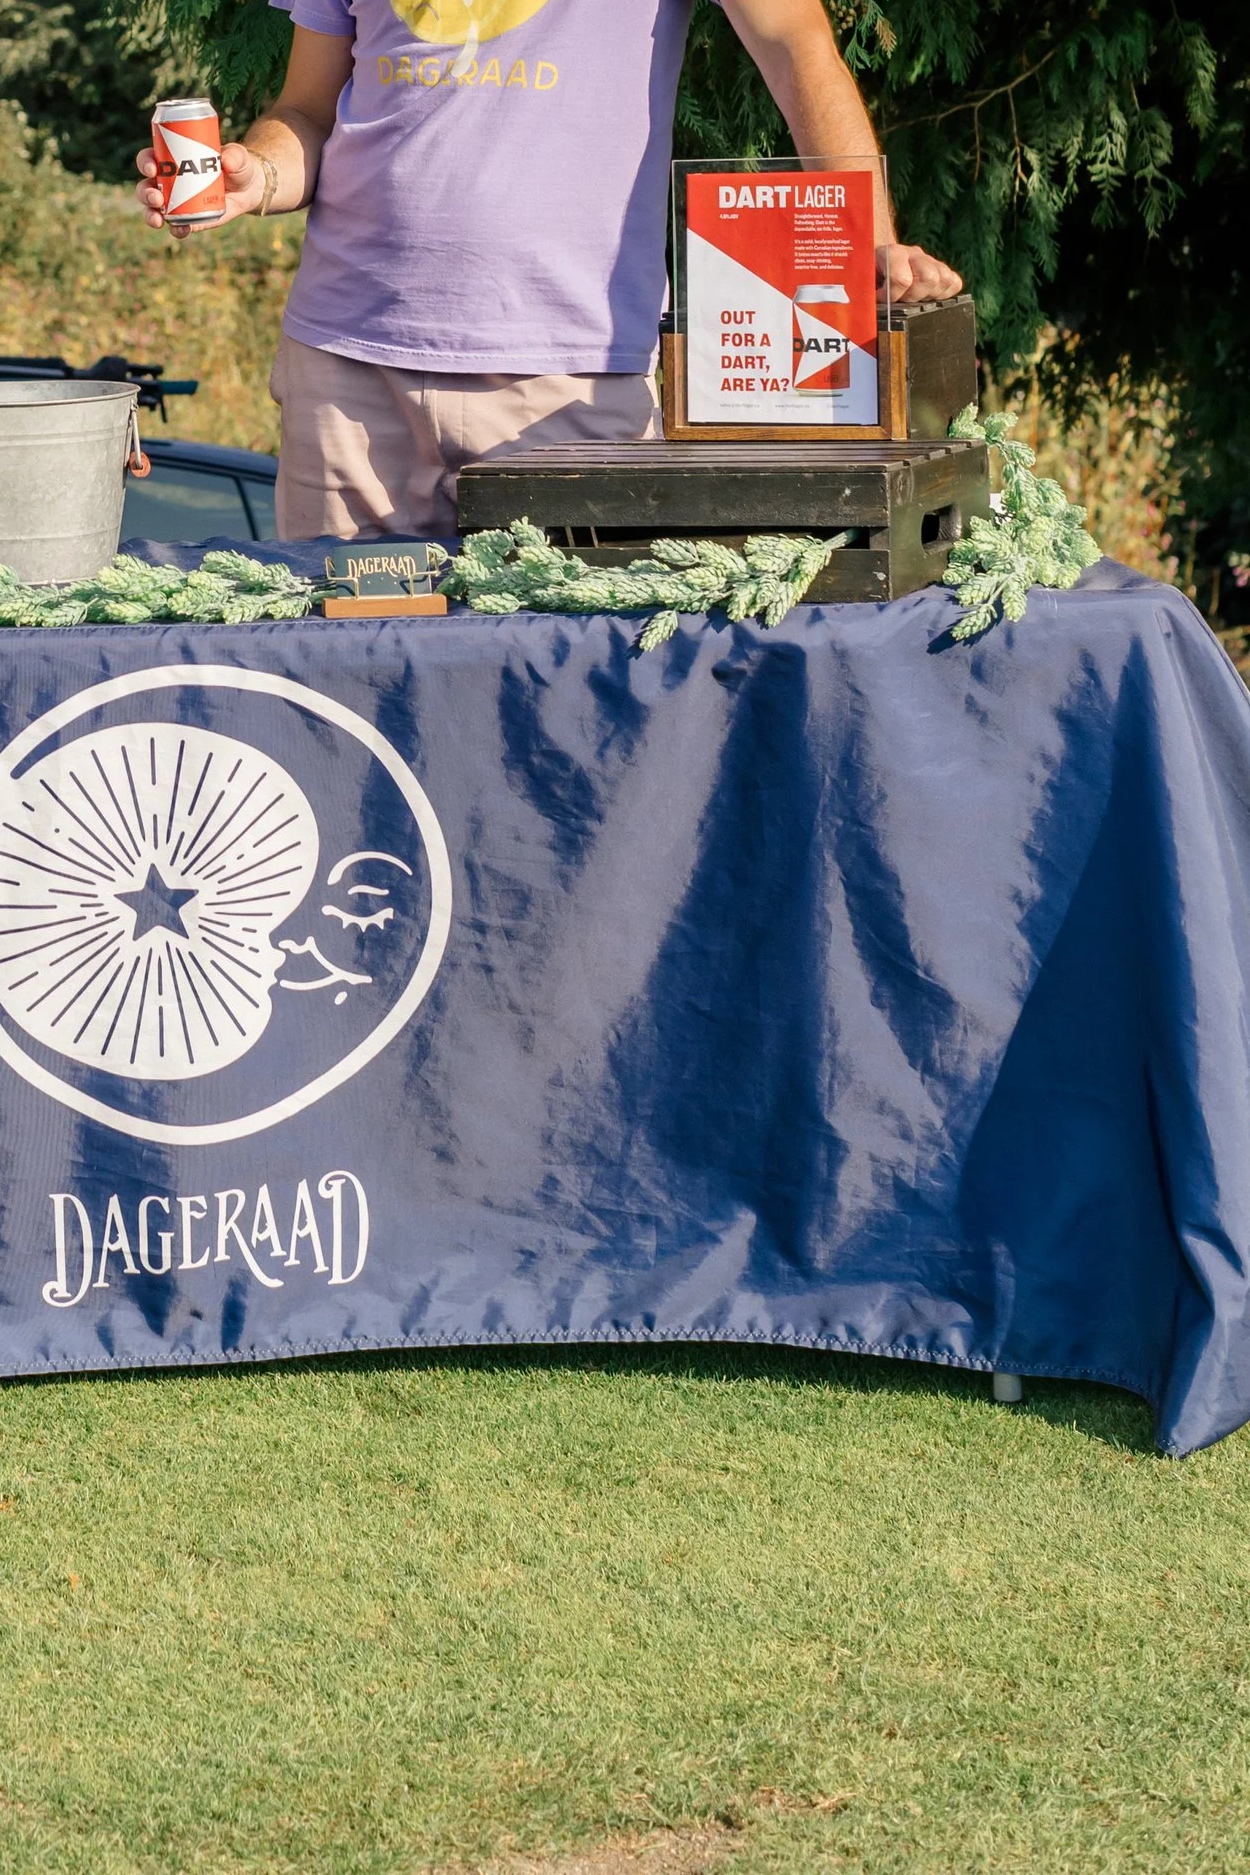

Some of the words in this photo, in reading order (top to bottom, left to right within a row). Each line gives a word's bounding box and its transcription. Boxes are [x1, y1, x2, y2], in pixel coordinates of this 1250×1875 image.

[158, 155, 222, 178] DAR
[718, 185, 791, 209] DART
[794, 185, 846, 208] LAGER
[720, 310, 755, 325] OUT
[721, 333, 755, 347] FOR
[760, 333, 771, 347] A
[721, 355, 770, 373] DART,
[720, 378, 755, 392] ARE
[760, 378, 790, 392] YA?
[347, 556, 416, 579] DAGERAAD
[42, 1170, 369, 1308] DAGERAAD
